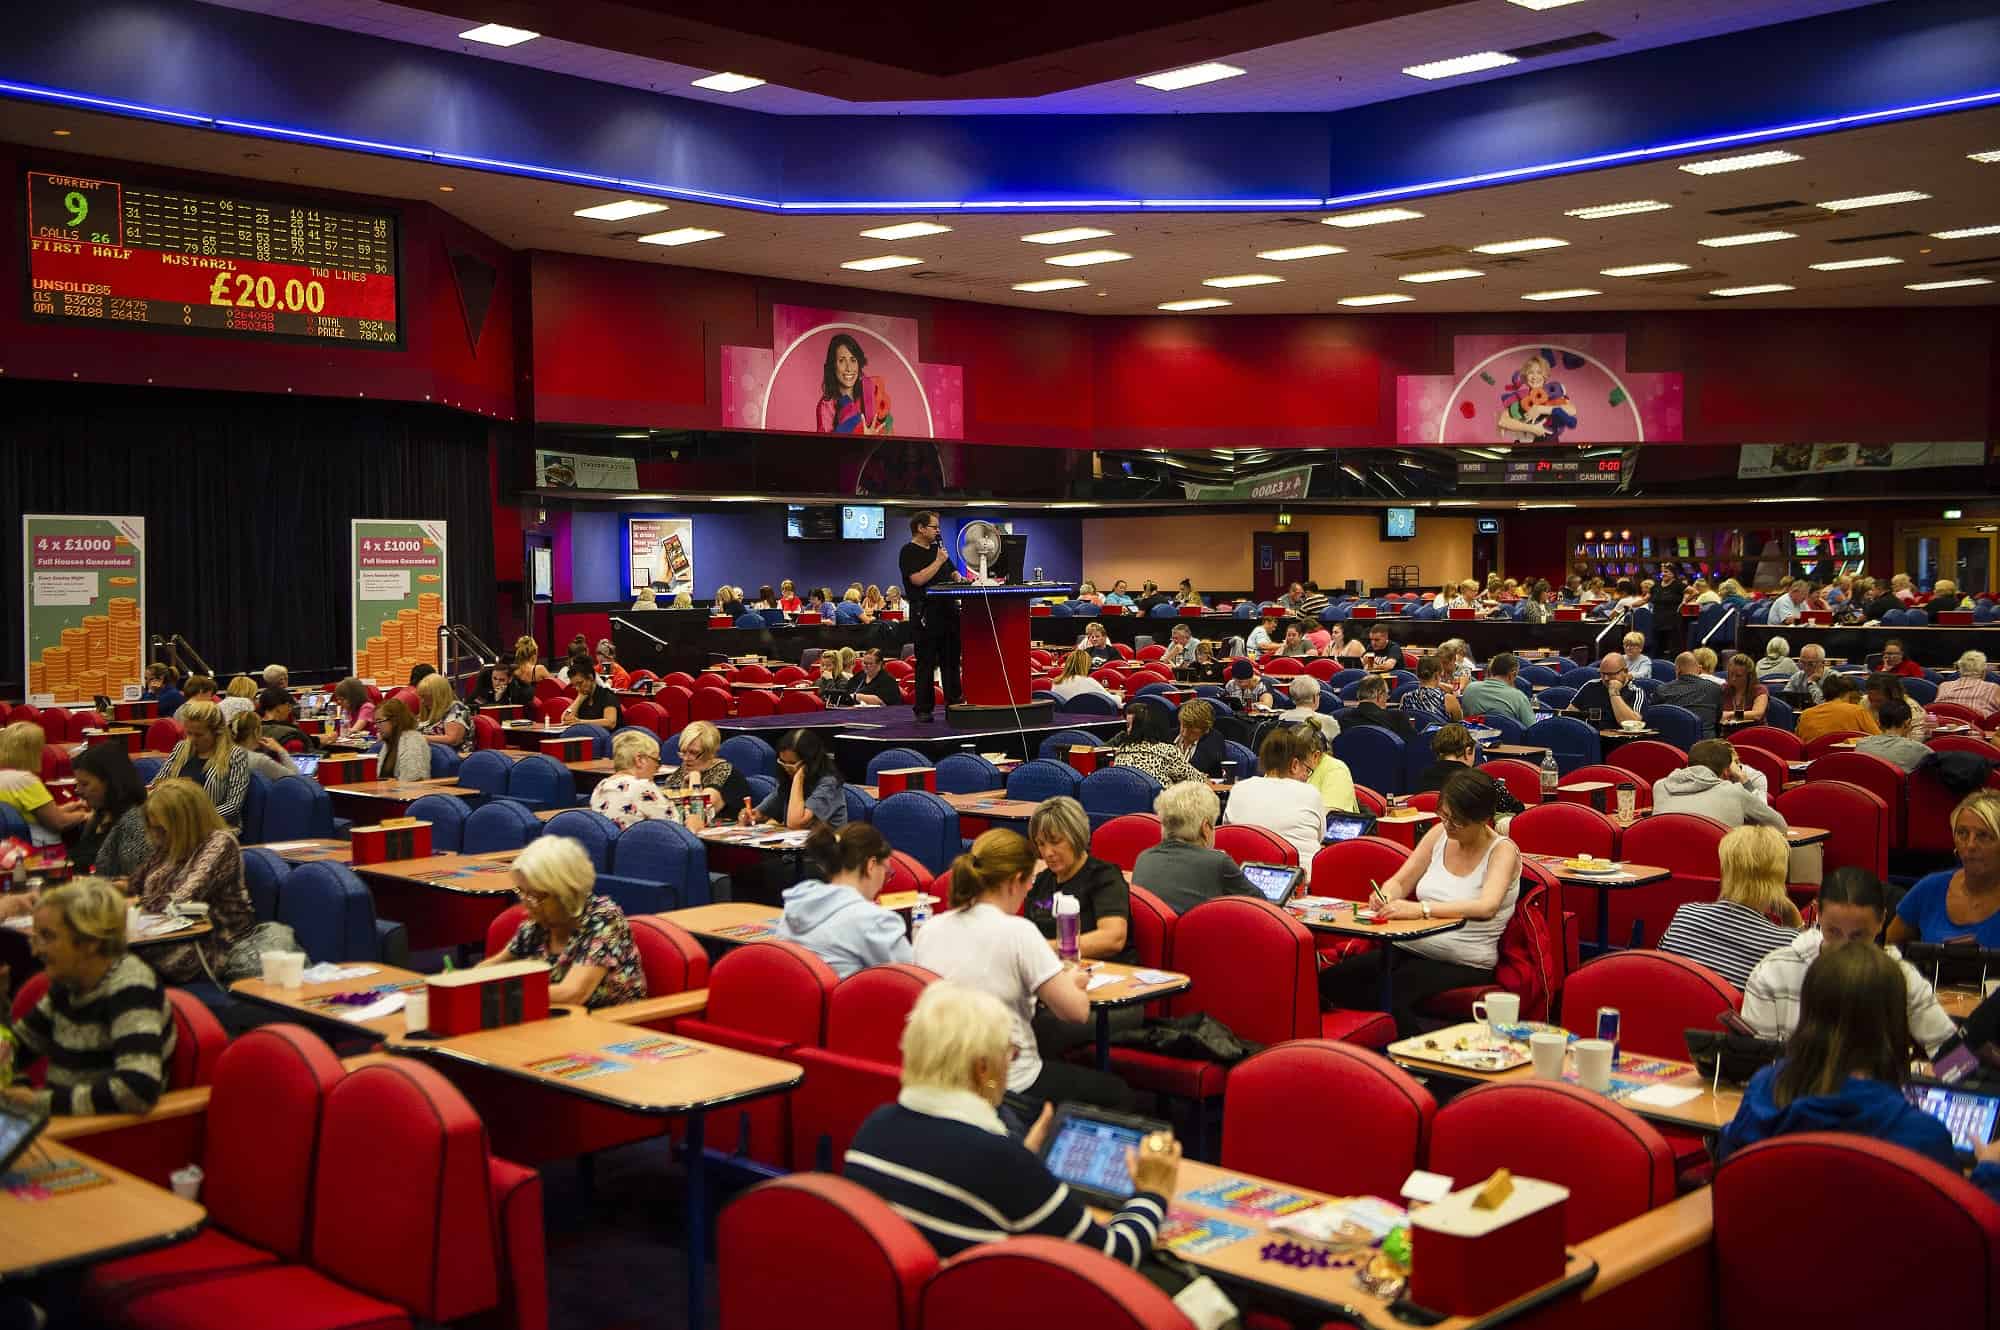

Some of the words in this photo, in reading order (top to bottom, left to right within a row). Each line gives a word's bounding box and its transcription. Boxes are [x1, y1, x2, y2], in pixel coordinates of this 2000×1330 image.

[48, 176, 101, 190] CURRENT
[64, 191, 89, 228] 9
[219, 200, 234, 211] 06
[290, 208, 304, 219] 10
[307, 210, 321, 221] 11
[125, 207, 141, 219] 31
[307, 230, 321, 240] 41
[183, 205, 198, 216] 19
[255, 213, 270, 225] 23
[324, 222, 338, 233] 27
[374, 228, 386, 239] 30
[40, 226, 80, 240] CALLS
[90, 232, 111, 244] 26
[126, 227, 142, 238] 61
[202, 236, 217, 246] 65
[291, 246, 305, 257] 70
[238, 230, 253, 241] 52
[324, 240, 338, 251] 57
[32, 239, 82, 255] FIRST
[92, 246, 133, 260] HALF
[184, 243, 199, 254] 79
[202, 246, 217, 256] 80
[256, 251, 271, 262] 83
[374, 264, 388, 274] 90
[310, 266, 329, 278] TWO
[335, 269, 367, 282] LINES
[209, 271, 325, 314] £20.00
[63, 294, 104, 307] 53203
[183, 304, 192, 315] 0
[317, 316, 341, 328] TOTAL
[359, 320, 383, 331] 9024
[110, 309, 149, 322] 26431
[183, 315, 192, 327] 0
[359, 330, 397, 343] 780.00
[859, 513, 869, 529] 9
[1398, 514, 1405, 529] 9
[38, 538, 48, 551] 4
[51, 541, 62, 551] x
[64, 538, 112, 552] £1000
[363, 540, 371, 552] 4
[374, 543, 381, 551] x
[383, 540, 421, 552] £1000
[38, 558, 54, 566] Full
